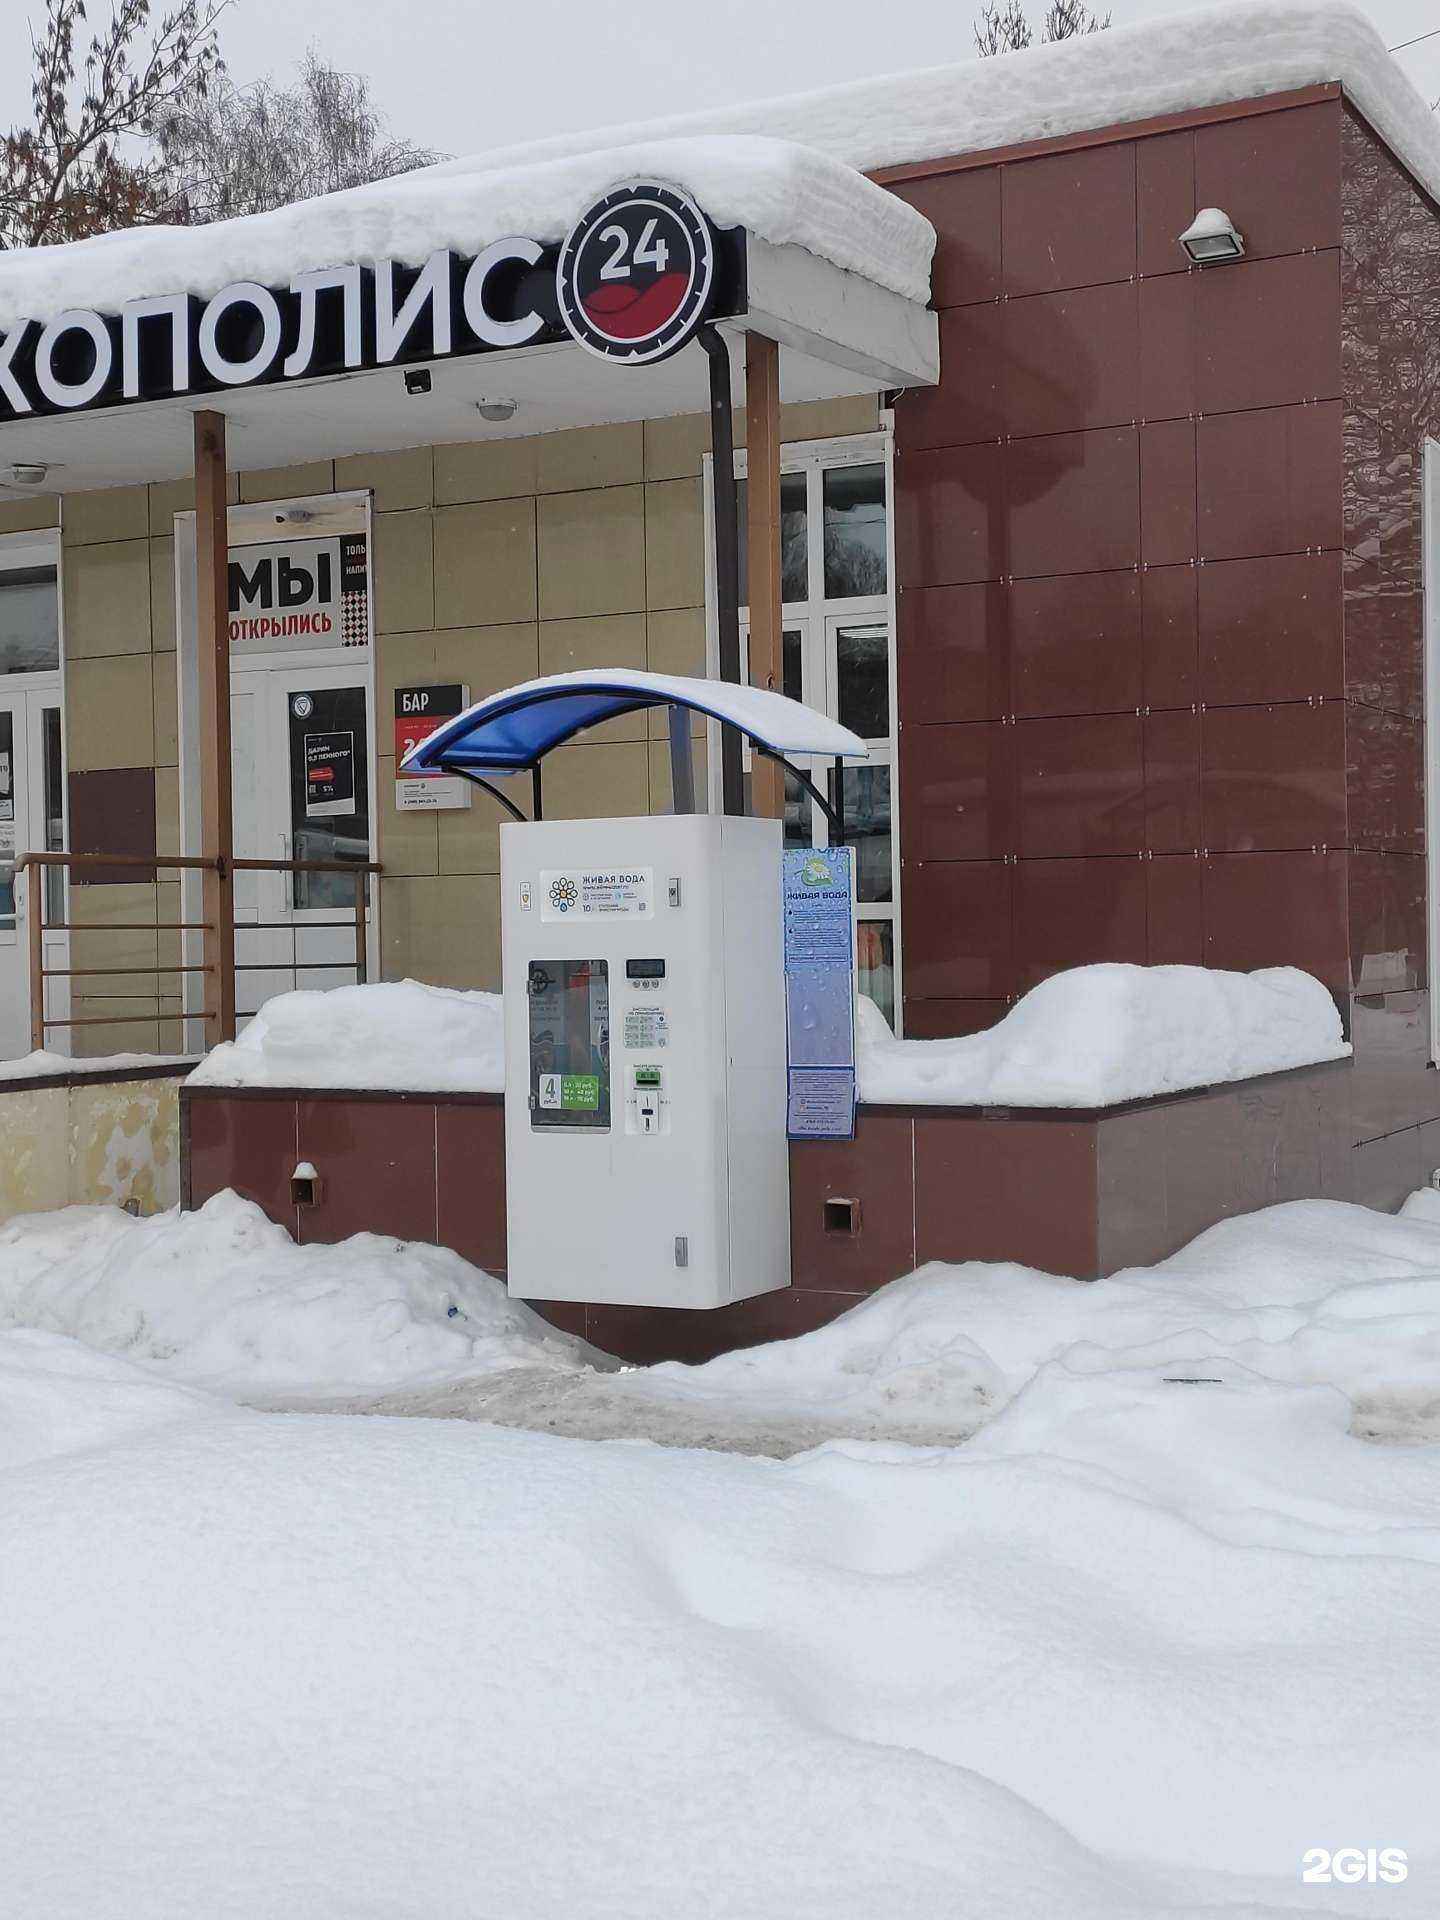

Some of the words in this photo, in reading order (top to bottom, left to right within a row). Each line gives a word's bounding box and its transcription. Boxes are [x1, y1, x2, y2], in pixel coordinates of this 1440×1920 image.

[599, 218, 669, 280] 24
[228, 553, 332, 612] МЫ
[229, 612, 332, 641] ОТКРЫЛИСЬ
[403, 693, 429, 712] БАР
[582, 875, 616, 884] ЖИВАЯ
[619, 875, 646, 883] ВОДА
[787, 892, 821, 900] ЖИВАЯ
[822, 891, 848, 899] ВОДА
[545, 1078, 556, 1099] 4
